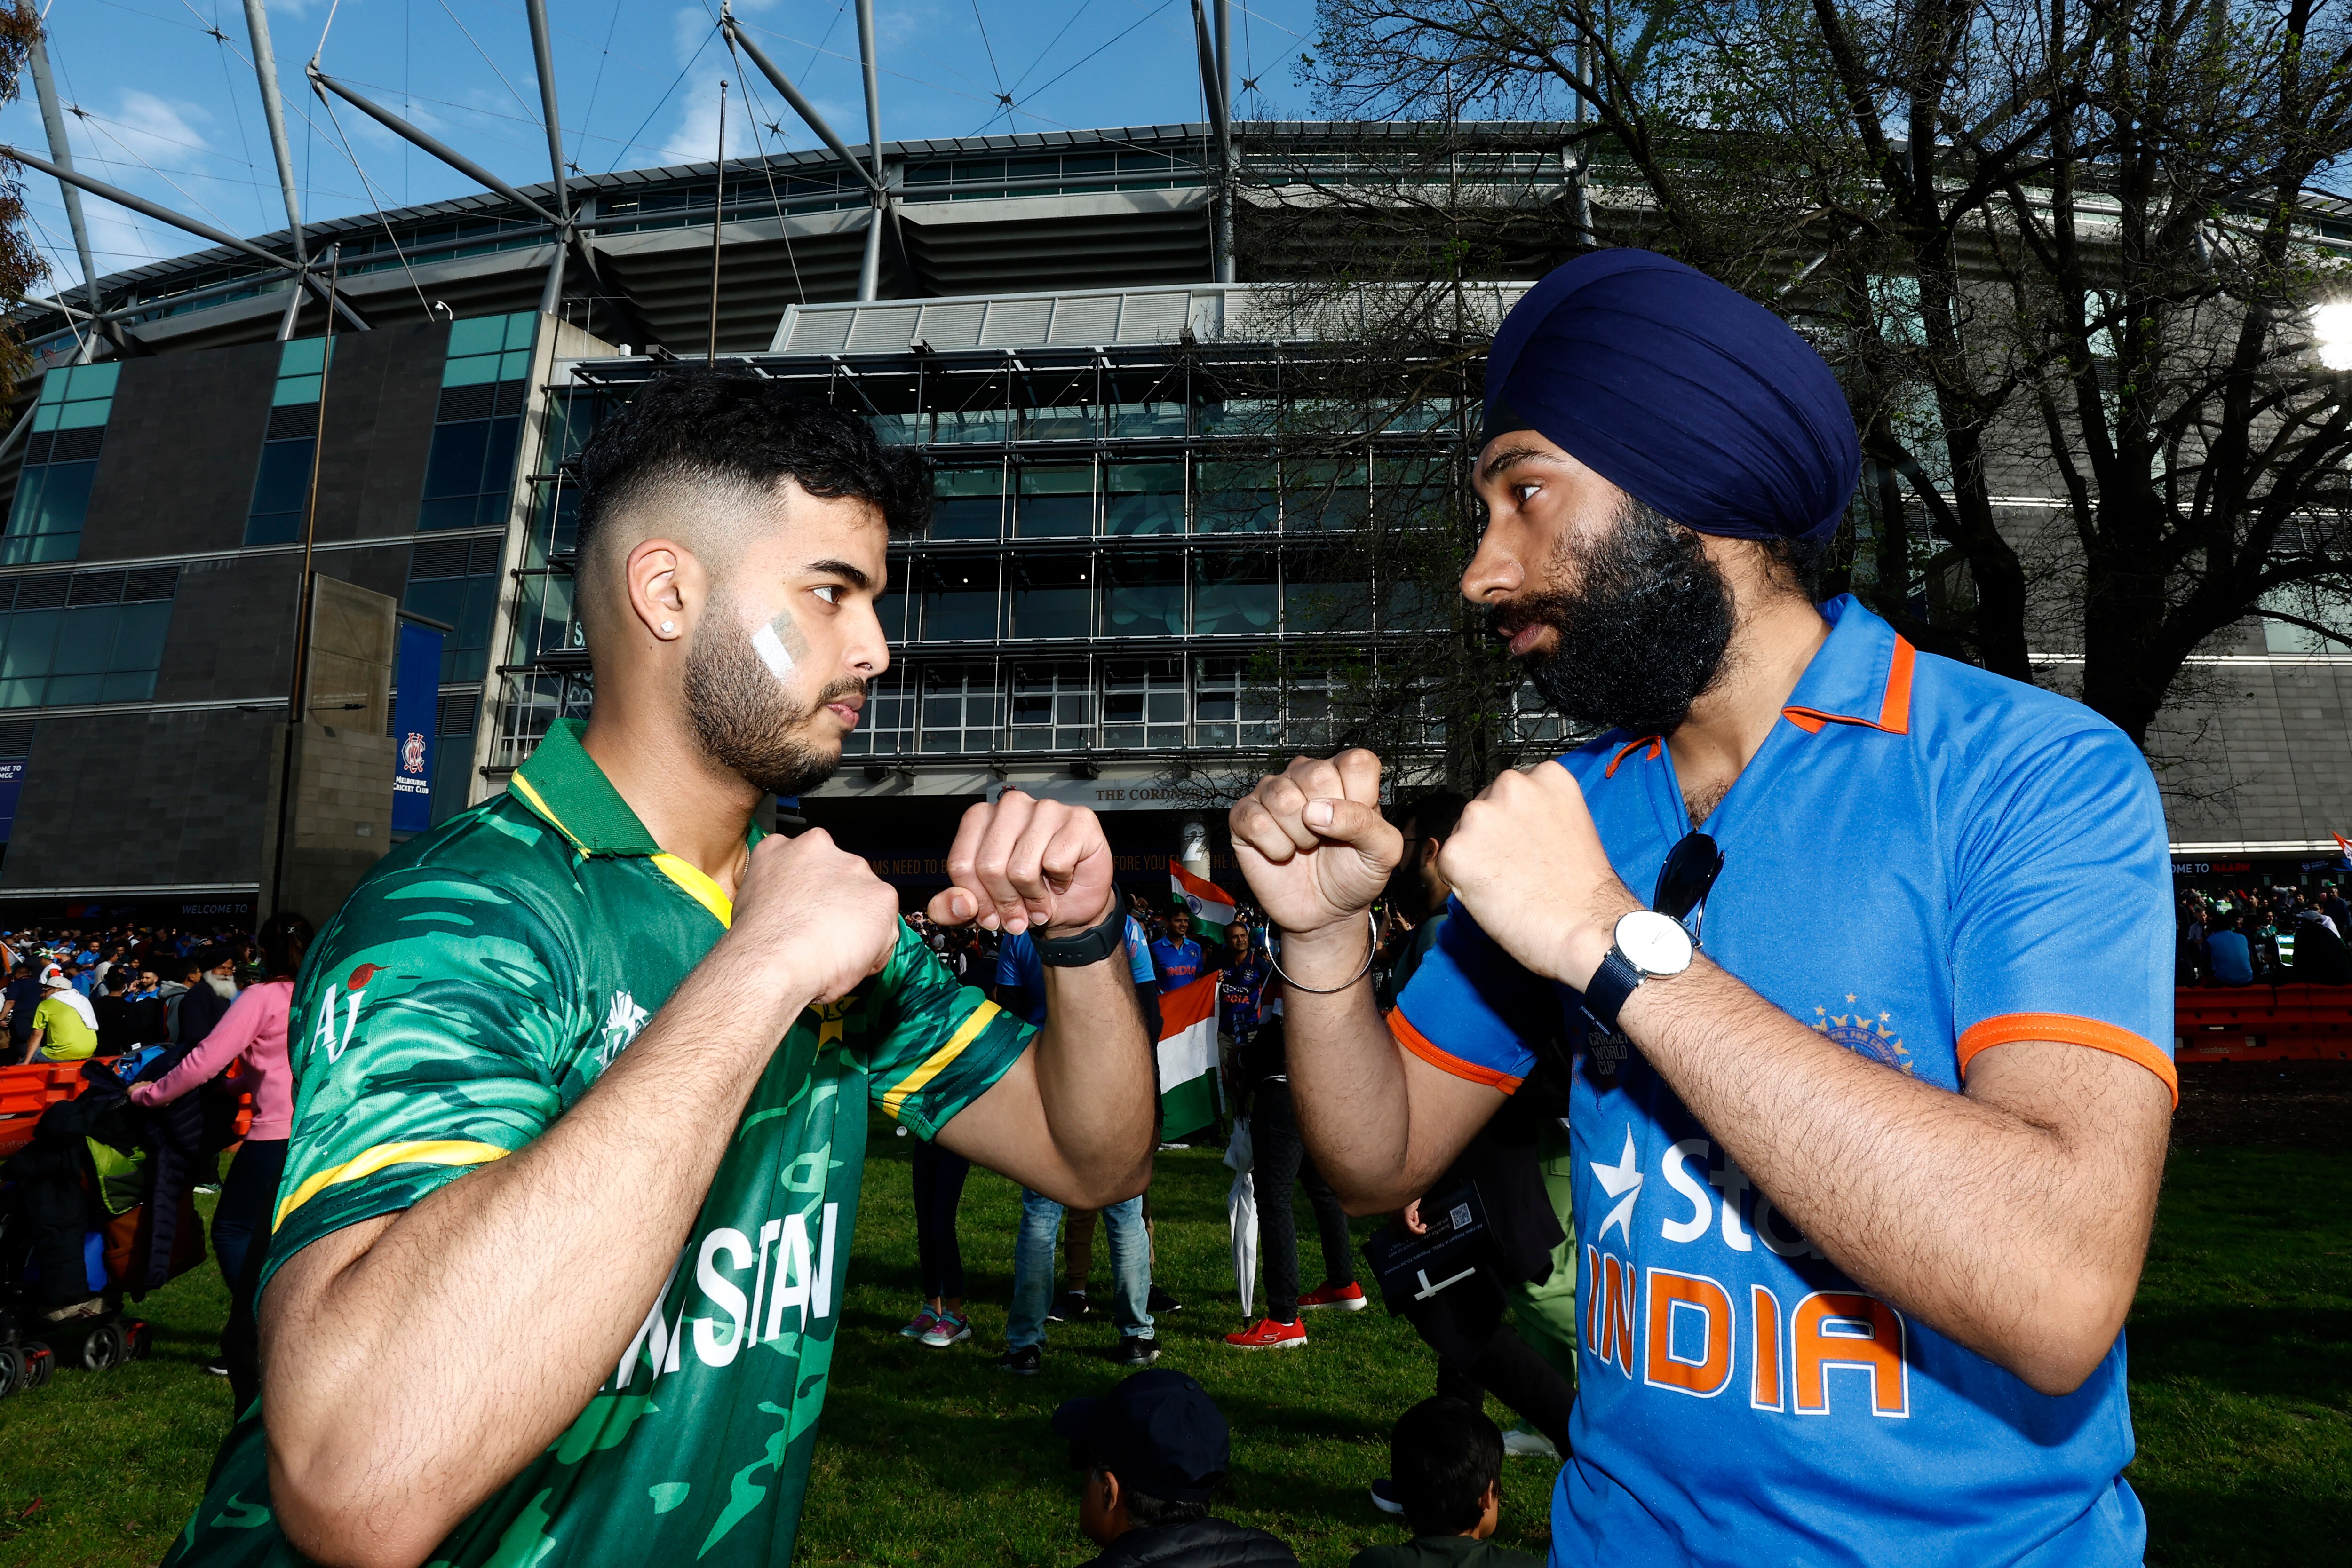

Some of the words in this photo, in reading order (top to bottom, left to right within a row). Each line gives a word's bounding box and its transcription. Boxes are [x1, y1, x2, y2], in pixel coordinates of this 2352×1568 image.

[396, 775, 427, 787] MELBOURNE
[415, 786, 429, 794] CLUB
[1096, 789, 1125, 800] THE
[892, 859, 921, 875] NEED
[923, 858, 937, 874] TO
[1113, 855, 1140, 870] FORE
[1144, 855, 1166, 870] YOU
[2195, 863, 2209, 873] TO
[2212, 862, 2251, 873] NAARM
[182, 904, 232, 914] WELCOME
[235, 903, 248, 913] TO
[1588, 1032, 1628, 1046] CRICKET
[1591, 1045, 1628, 1060] WORLD
[1597, 1061, 1616, 1075] CUP
[1586, 1243, 1910, 1418] INDIA
